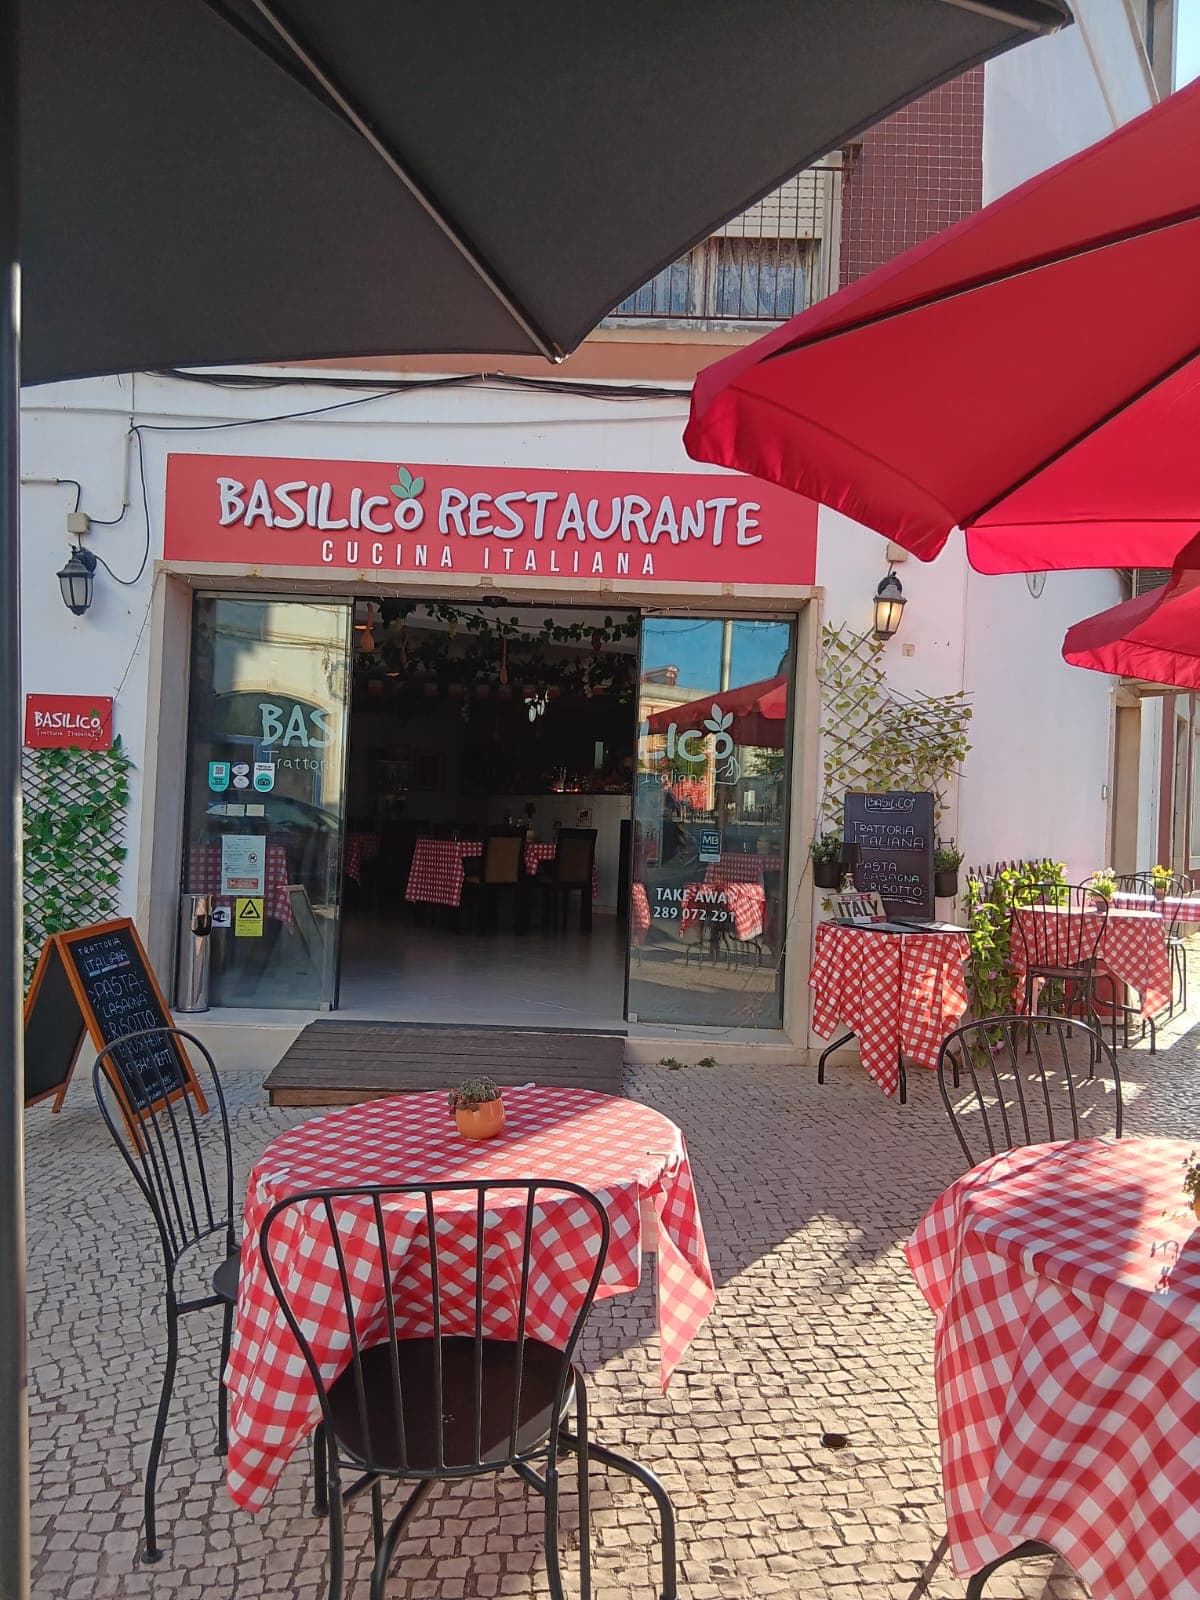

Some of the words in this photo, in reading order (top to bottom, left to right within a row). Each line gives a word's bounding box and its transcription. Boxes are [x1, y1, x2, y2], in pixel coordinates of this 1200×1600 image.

[217, 477, 426, 534] BASILICO
[438, 487, 763, 547] RESTAURANTE
[322, 539, 453, 568] CUCINA
[484, 546, 654, 575] ITALIANA
[34, 711, 101, 729] BASILICO
[702, 835, 719, 845] MB
[853, 835, 924, 849] ITALIANA
[656, 887, 690, 902] TAKE
[653, 906, 678, 919] 289
[682, 908, 707, 921] 072
[711, 910, 736, 923] 291
[837, 900, 879, 918] ITALY
[94, 973, 142, 1000] PASTA
